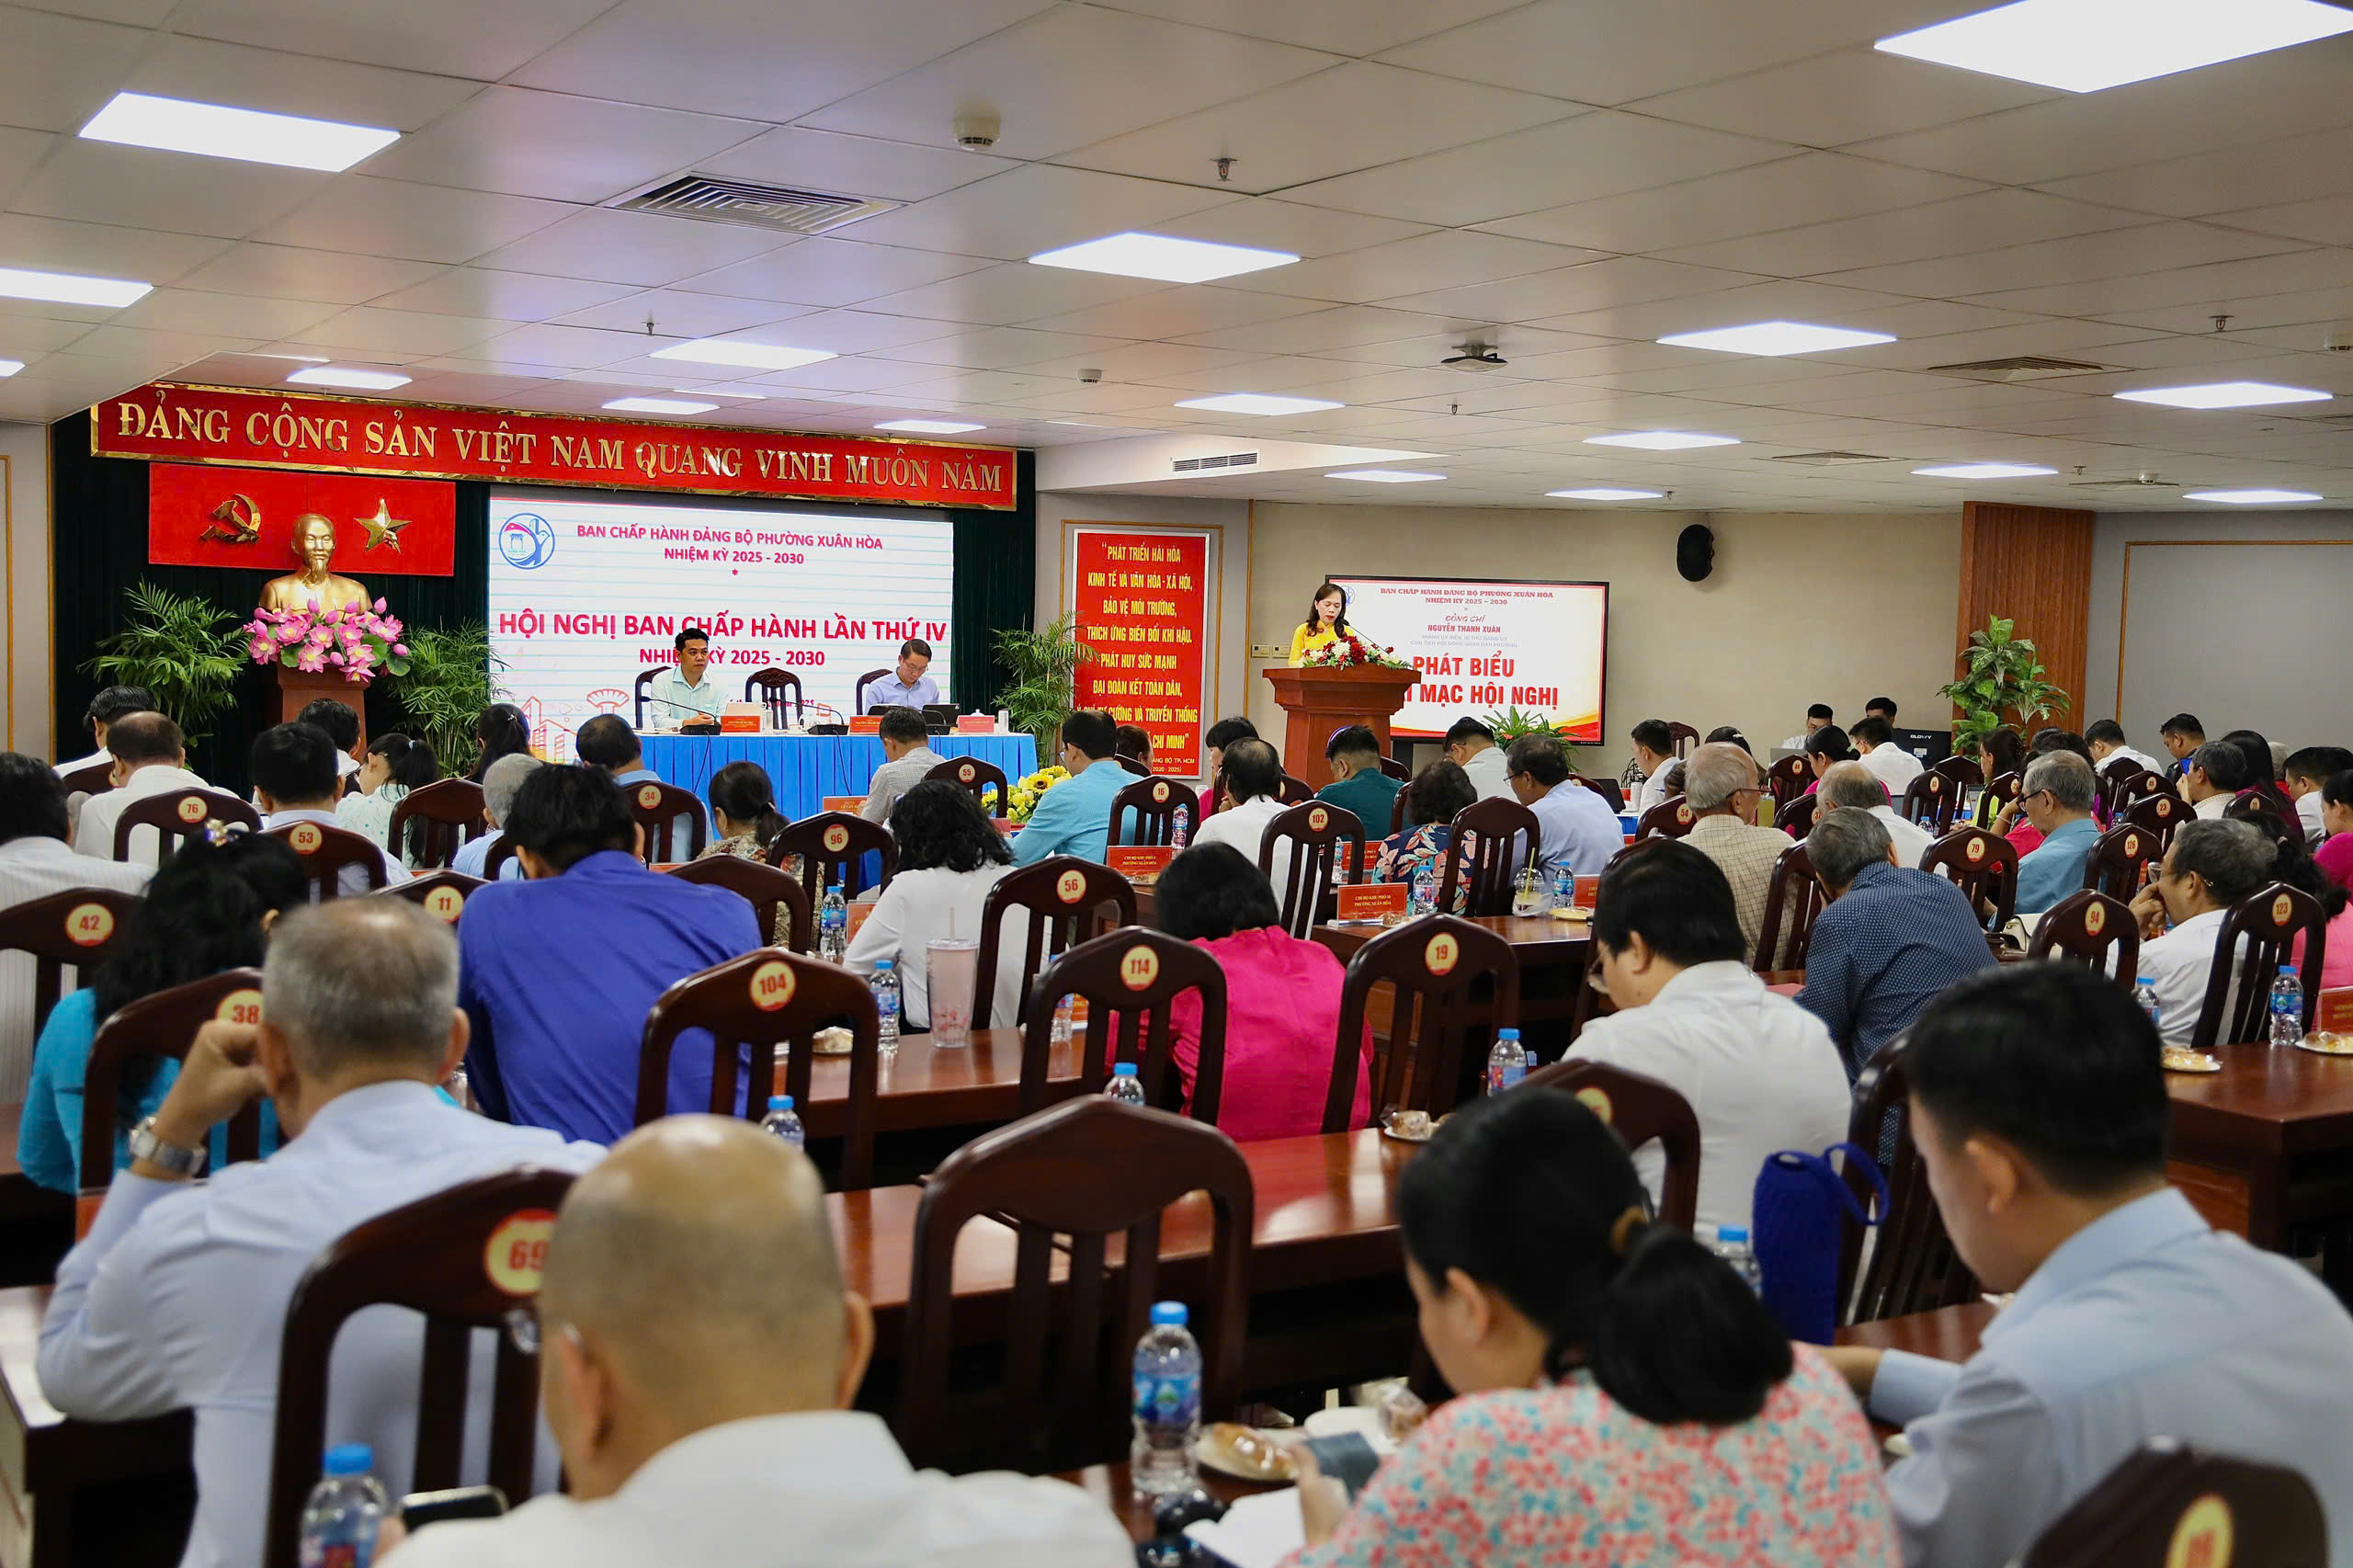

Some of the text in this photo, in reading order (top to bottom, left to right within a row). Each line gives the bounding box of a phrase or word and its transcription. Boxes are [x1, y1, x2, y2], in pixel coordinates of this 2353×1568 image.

[118, 390, 1003, 492] ĐẢNG CỘNG SẢN VIỆT NAM QUANG VINH MUÔN NĂM
[577, 523, 882, 550] BAN CHẤP HÀNH ĐẢNG BỘ PHƯỜNG XUÂN HÒA
[665, 546, 709, 562] NHIỆM
[712, 548, 729, 562] KỲ
[733, 551, 763, 562] 2025
[774, 552, 804, 564] 2030
[1129, 541, 1149, 561] TRIỂN
[1152, 545, 1164, 562] HÀI
[1088, 573, 1105, 586] KINH
[1108, 569, 1117, 587] TẾ
[1120, 570, 1127, 587] VÀ
[1131, 571, 1143, 587] VĂN
[1179, 574, 1193, 592] HỘI,
[1103, 596, 1118, 614] BẢO
[1120, 598, 1128, 617] VỆ
[1131, 598, 1144, 615] MÔI
[499, 608, 544, 639] HỘI
[553, 614, 616, 640] NGHỊ
[624, 615, 674, 635] BAN
[751, 613, 816, 639] HÀNH
[824, 612, 865, 640] LẦN
[872, 617, 919, 641] THỨ
[926, 622, 947, 641] IV
[1087, 623, 1108, 641] THÍCH
[1110, 624, 1126, 642] ỨNG
[1129, 624, 1145, 642] BIẾN
[1162, 626, 1175, 642] KHÍ
[731, 651, 770, 665] 2025
[786, 651, 824, 665] 2030
[1101, 651, 1176, 672] PHÁT HUY SỨC MẠNH
[1413, 650, 1514, 677] PHÁT BIỂU
[1093, 680, 1105, 697] ĐẠI
[1108, 678, 1127, 695] ĐOÀN
[1129, 677, 1142, 695] KẾT
[1145, 679, 1164, 695] TOÀN
[1419, 684, 1462, 707] MẠC
[1471, 681, 1504, 708] HỘI
[1511, 687, 1558, 710] NGHỊ
[1135, 706, 1143, 721] VÀ
[1175, 704, 1198, 722] THỐNG
[1153, 733, 1164, 749] CHÍ
[644, 792, 655, 800] 34
[187, 804, 199, 812] 76
[1679, 809, 1690, 818] 54
[1313, 814, 1325, 824] 102
[298, 832, 314, 845] 53
[830, 835, 843, 846] 96
[2126, 840, 2136, 850] 126
[1971, 842, 1980, 854] 79
[1064, 879, 1078, 891] 56
[438, 897, 451, 911] 11
[2276, 902, 2289, 915] 123
[79, 915, 100, 931] 42
[2090, 912, 2100, 925] 94
[1435, 945, 1449, 960] 19
[1131, 959, 1150, 975] 114
[759, 975, 787, 995] 104
[233, 1005, 259, 1025] 38
